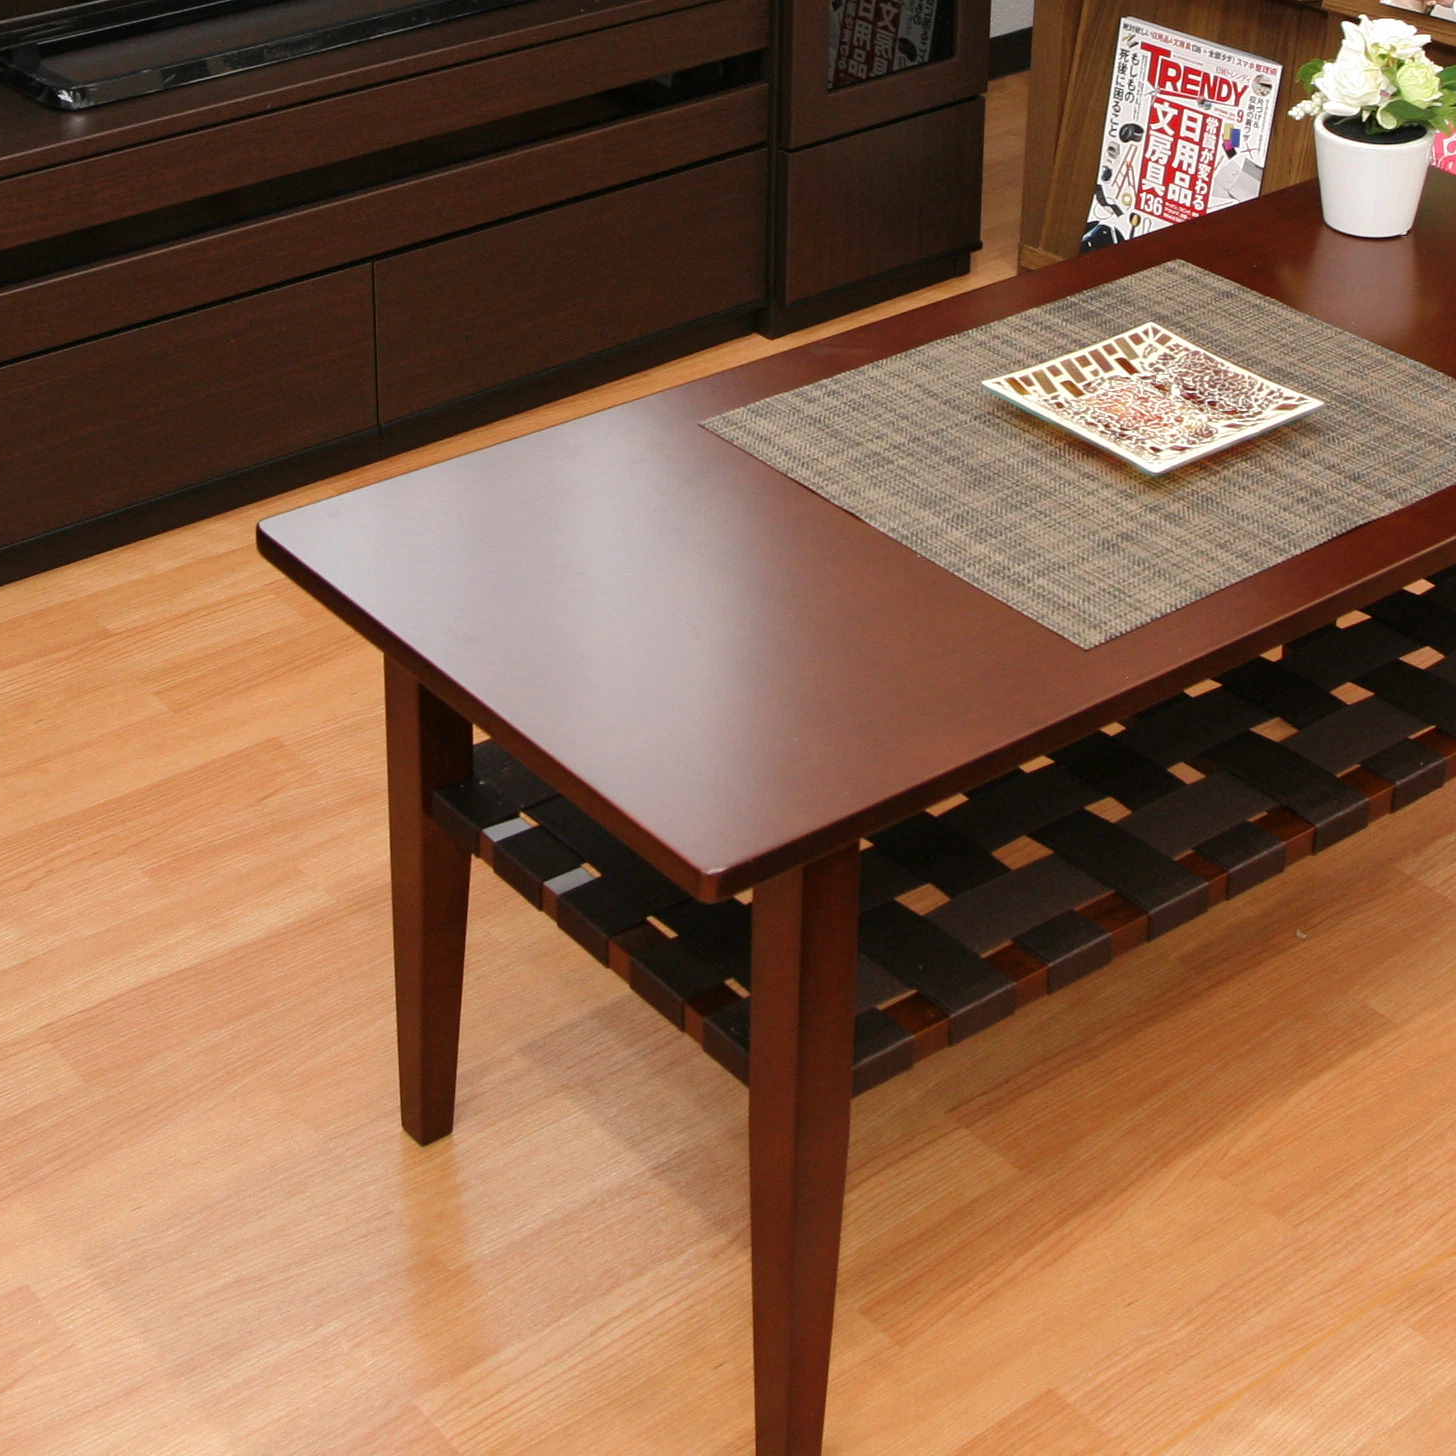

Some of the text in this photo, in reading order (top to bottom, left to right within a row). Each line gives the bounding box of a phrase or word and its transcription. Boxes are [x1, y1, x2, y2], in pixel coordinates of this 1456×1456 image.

[1108, 48, 1130, 139] 死後に困ること
[1125, 52, 1140, 103] もしもの
[1140, 41, 1249, 107] TRENDY
[1142, 101, 1179, 197] 文房具
[1237, 110, 1244, 124] 9
[1167, 110, 1203, 208] 日用品
[1193, 116, 1220, 211] 常識が変わる
[1138, 192, 1163, 217] 136
